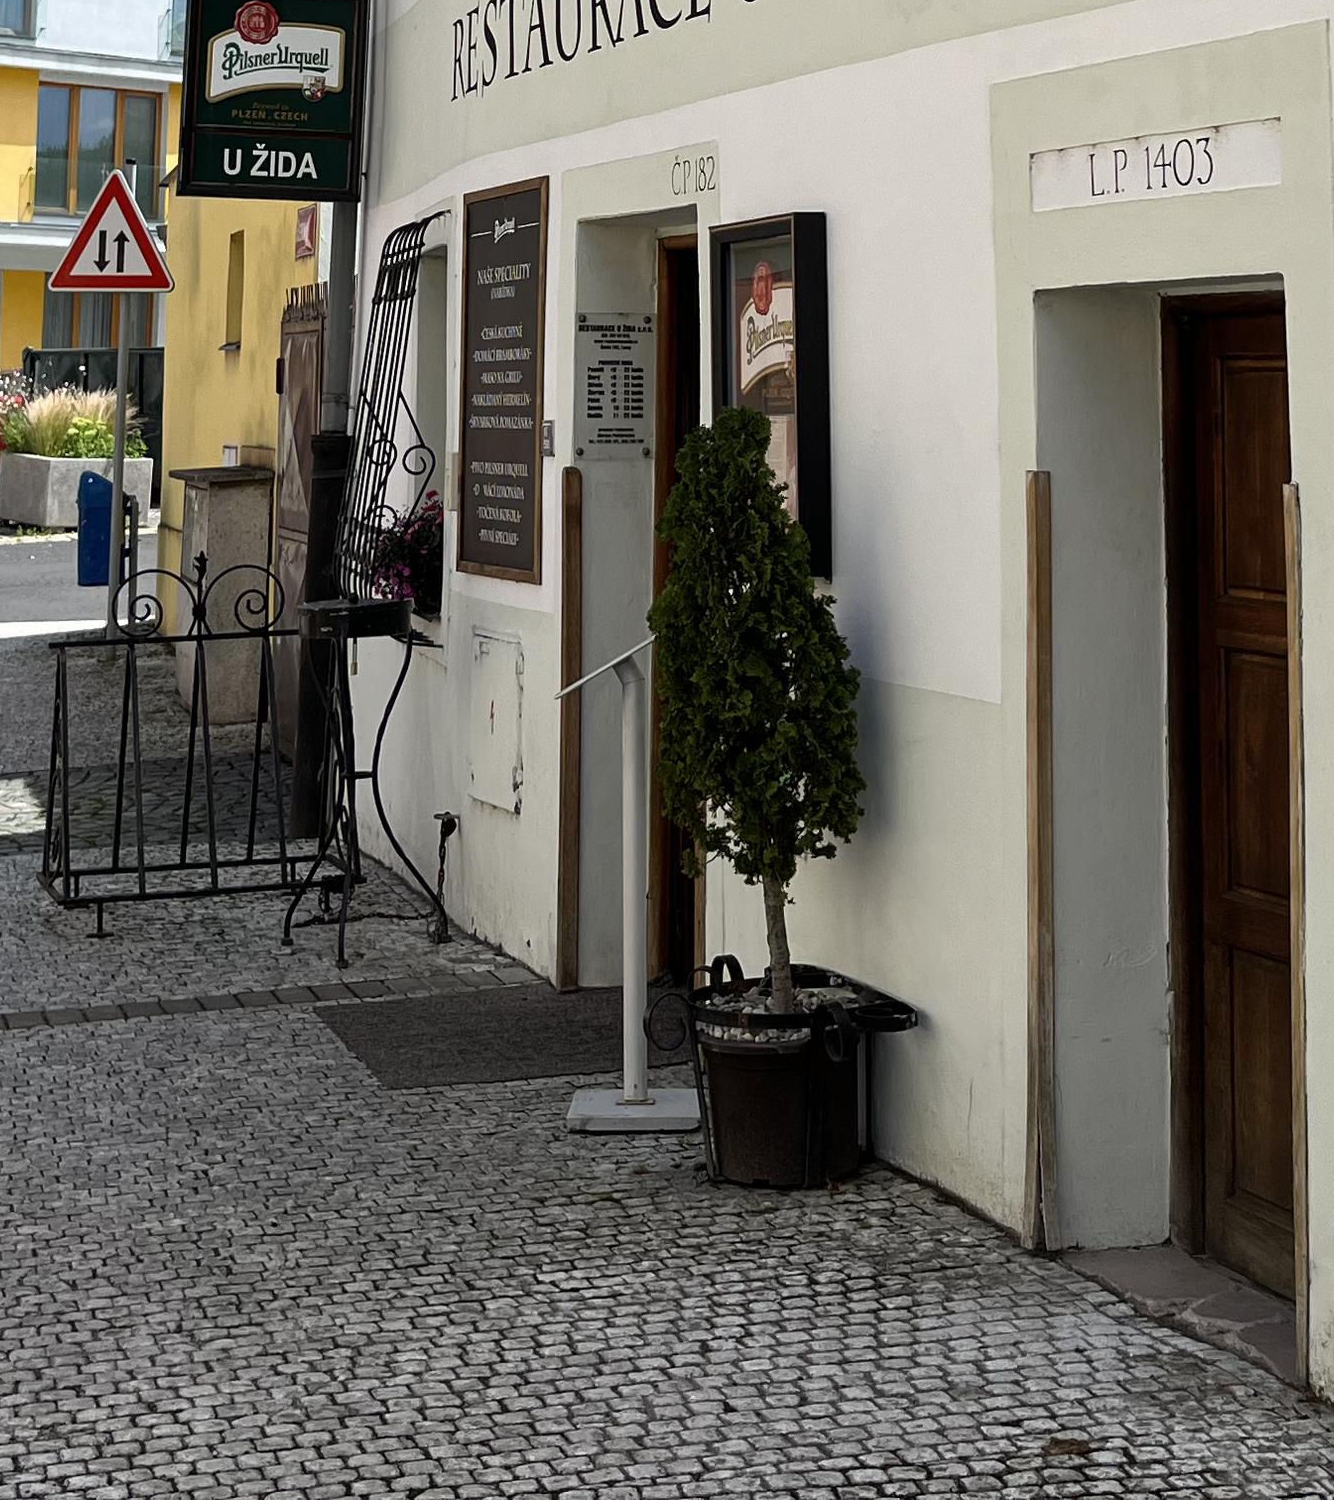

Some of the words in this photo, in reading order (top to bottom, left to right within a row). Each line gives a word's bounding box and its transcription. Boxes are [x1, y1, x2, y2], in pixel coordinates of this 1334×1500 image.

[221, 42, 277, 80] Pilsner
[277, 44, 329, 73] Urquell
[273, 111, 308, 121] CZECH
[223, 148, 242, 176] U
[250, 143, 318, 179] ŽIDA
[695, 155, 716, 192] 182
[1144, 136, 1214, 190] 1403
[494, 263, 531, 282] SPECIALITY
